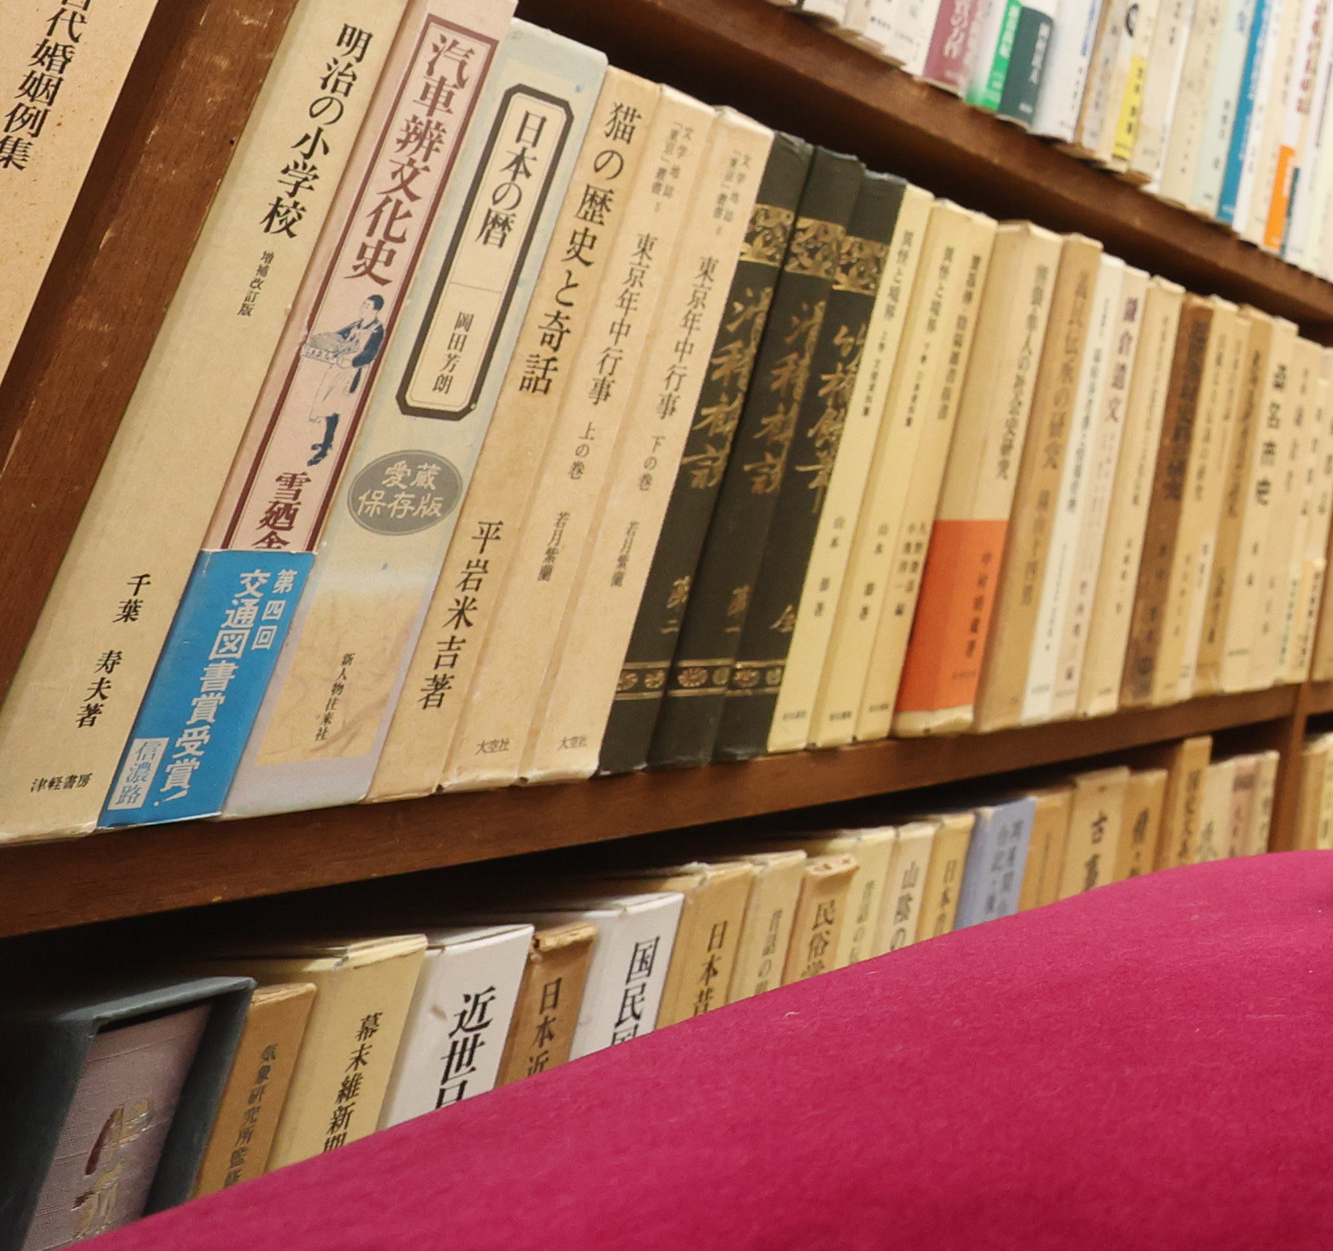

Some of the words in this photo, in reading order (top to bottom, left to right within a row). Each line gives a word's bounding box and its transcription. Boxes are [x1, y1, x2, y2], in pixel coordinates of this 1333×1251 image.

[260, 23, 373, 239] 明治の小学校
[344, 33, 476, 288] 汽車辨文化史
[474, 110, 549, 250] 日本の暦
[236, 250, 275, 319] 増補改訂版
[518, 101, 643, 398] 猫の歴史と奇話
[431, 310, 474, 396] 岡田芳朗
[587, 231, 660, 406] 東京年中行事
[656, 254, 722, 422] 東京年中行事
[381, 459, 443, 491] 愛蔵
[568, 419, 597, 481] 上の巻
[635, 432, 668, 492] 下の巻
[356, 490, 446, 521] 保存版
[113, 573, 152, 625] 千葉
[251, 569, 299, 652] 第四回
[418, 519, 505, 711] 平岩米吉著
[75, 649, 123, 730] 寿夫著
[315, 652, 356, 742] 新人物往来社
[30, 771, 93, 795] 津軽書房
[116, 740, 163, 806] 信濃路
